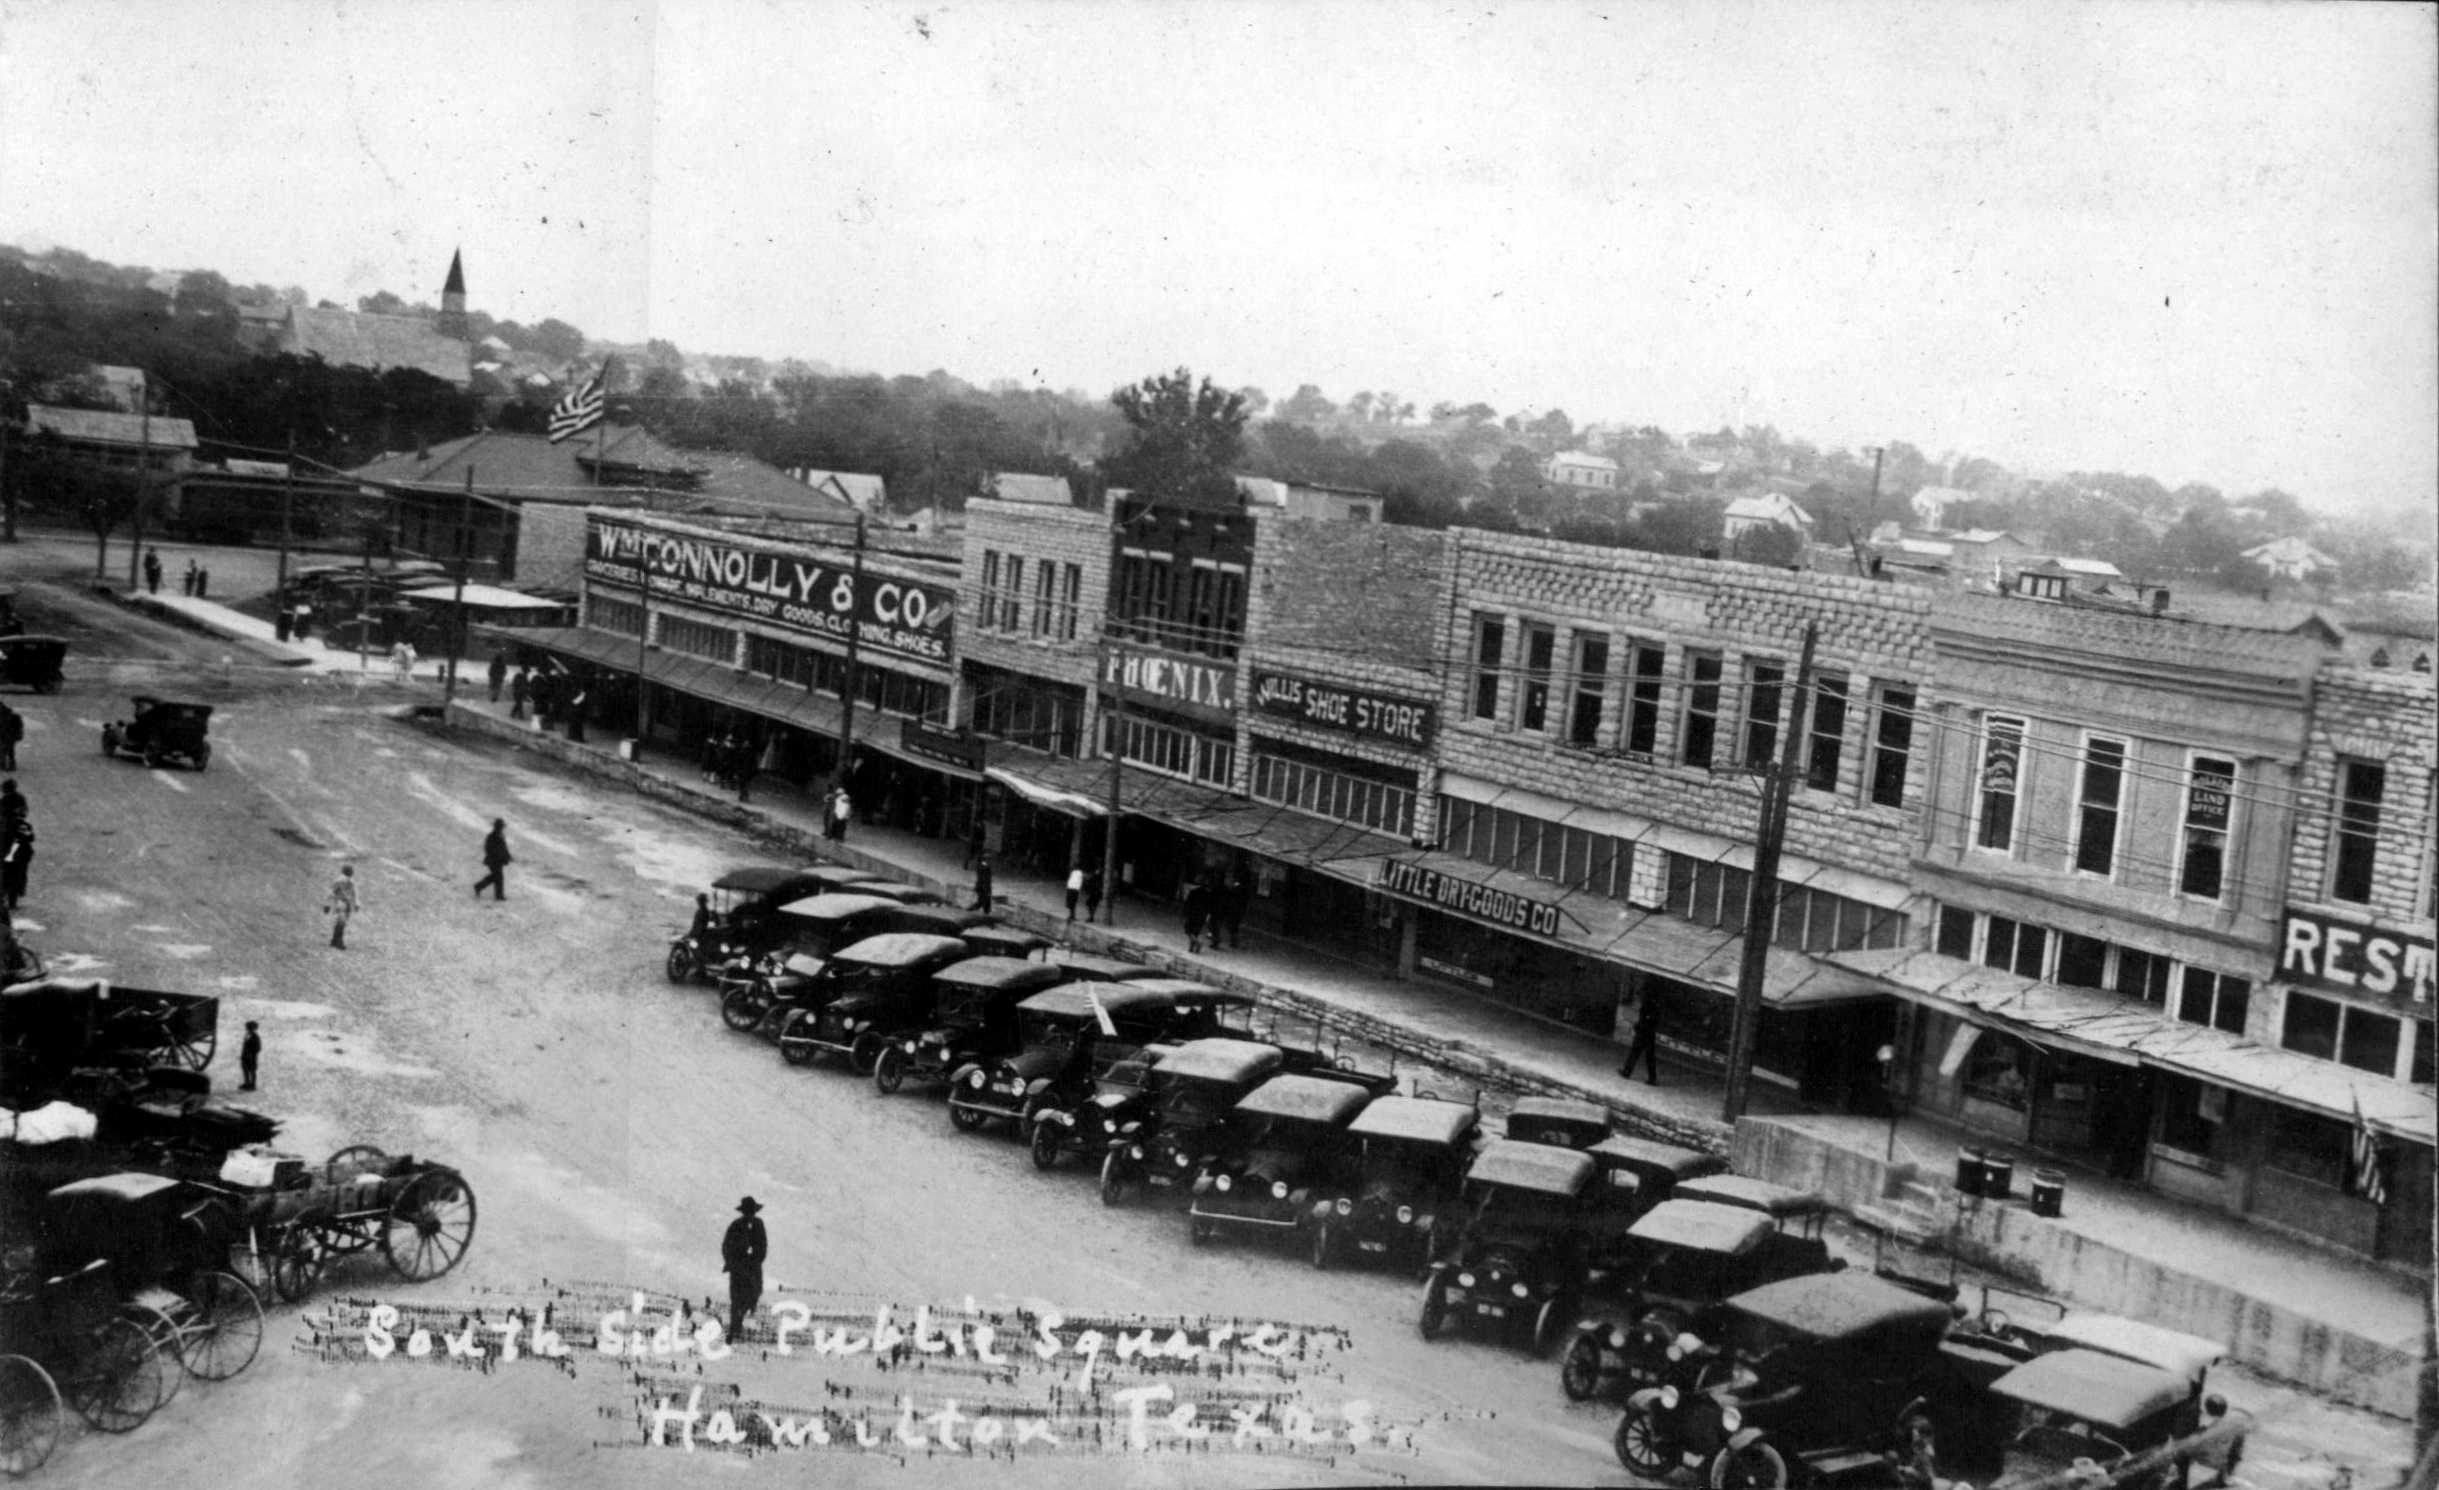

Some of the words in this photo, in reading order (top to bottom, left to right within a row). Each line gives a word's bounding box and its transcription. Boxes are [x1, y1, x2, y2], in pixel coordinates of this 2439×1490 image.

[643, 532, 823, 602] CONNOLLY
[831, 574, 854, 612] &
[754, 596, 778, 616] DRY
[1256, 677, 1301, 706] WILLIS
[1305, 688, 1350, 725] SHOE
[1356, 698, 1425, 742] STORE
[1380, 858, 1436, 898] LITTLE
[1531, 901, 1557, 935] CO
